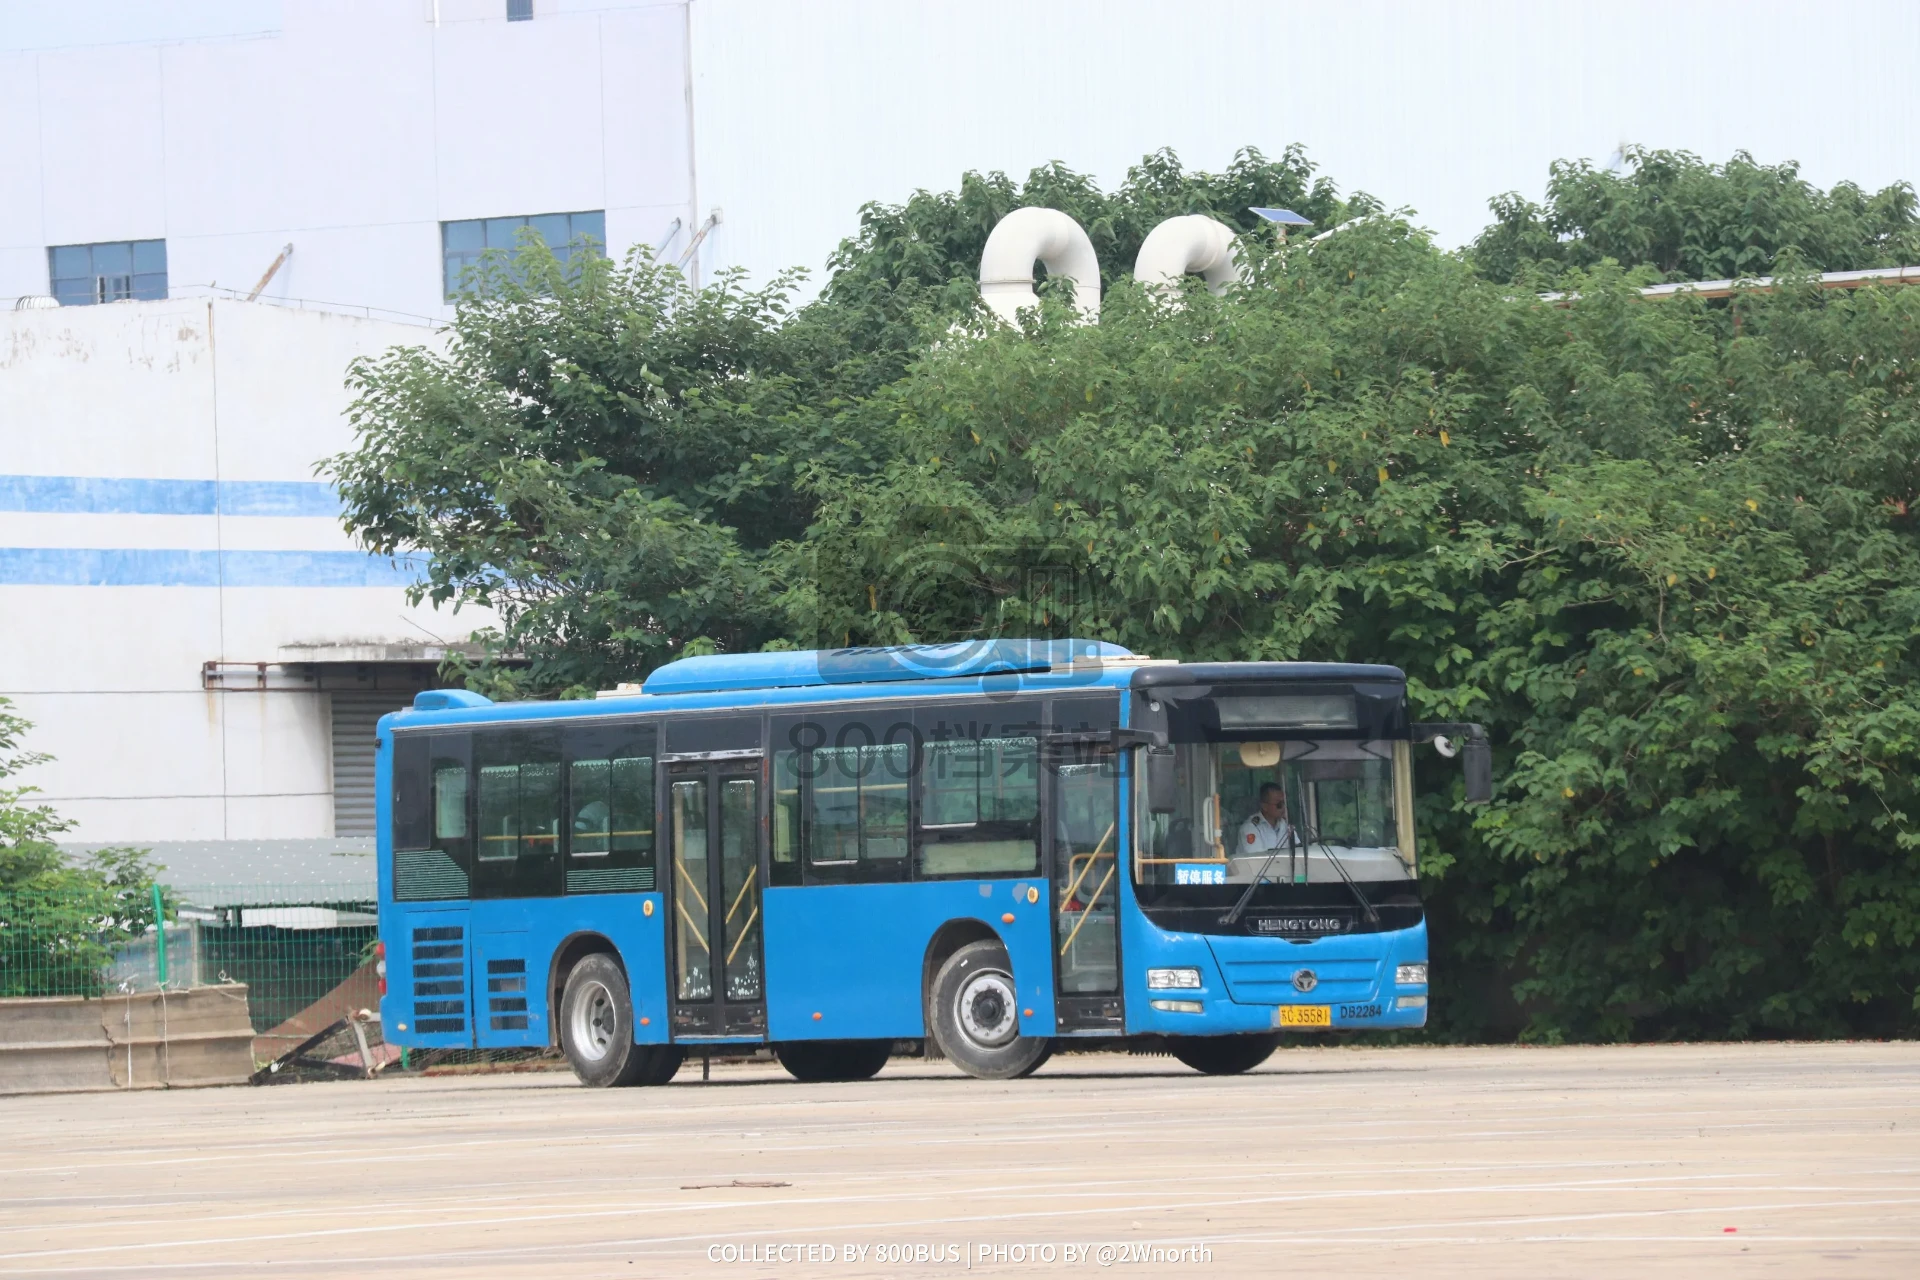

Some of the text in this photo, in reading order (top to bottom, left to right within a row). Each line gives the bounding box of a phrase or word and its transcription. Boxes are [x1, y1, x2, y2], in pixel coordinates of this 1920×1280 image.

[1177, 869, 1225, 885] 暂停服务
[1258, 918, 1340, 931] HENGTONG
[1340, 1005, 1382, 1019] DB2284
